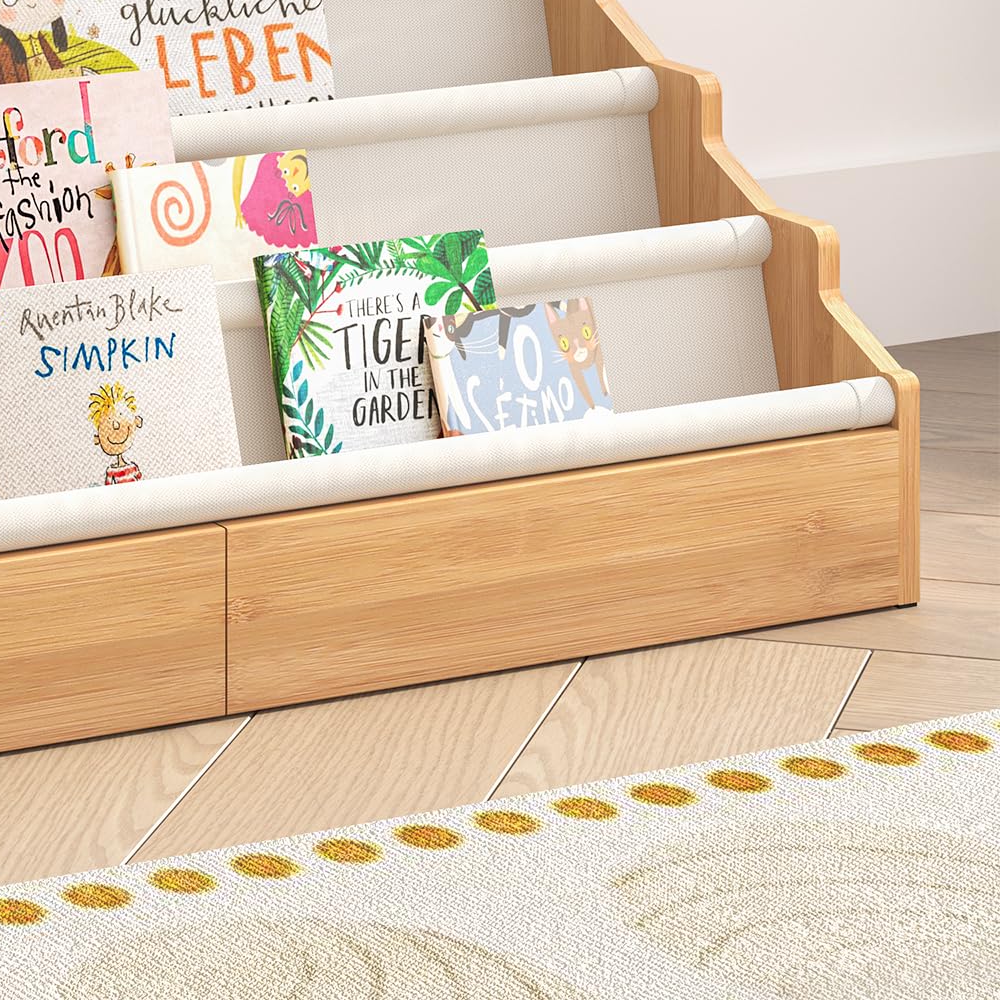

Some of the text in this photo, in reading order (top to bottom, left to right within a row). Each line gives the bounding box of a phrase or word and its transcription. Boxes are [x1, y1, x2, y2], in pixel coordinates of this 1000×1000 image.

[2, 169, 41, 195] the
[20, 287, 184, 341] Quentin Blake
[345, 292, 421, 319] THERE'S A
[34, 332, 177, 378] SIMPKIN
[512, 324, 543, 391] O
[364, 366, 423, 393] IN THE
